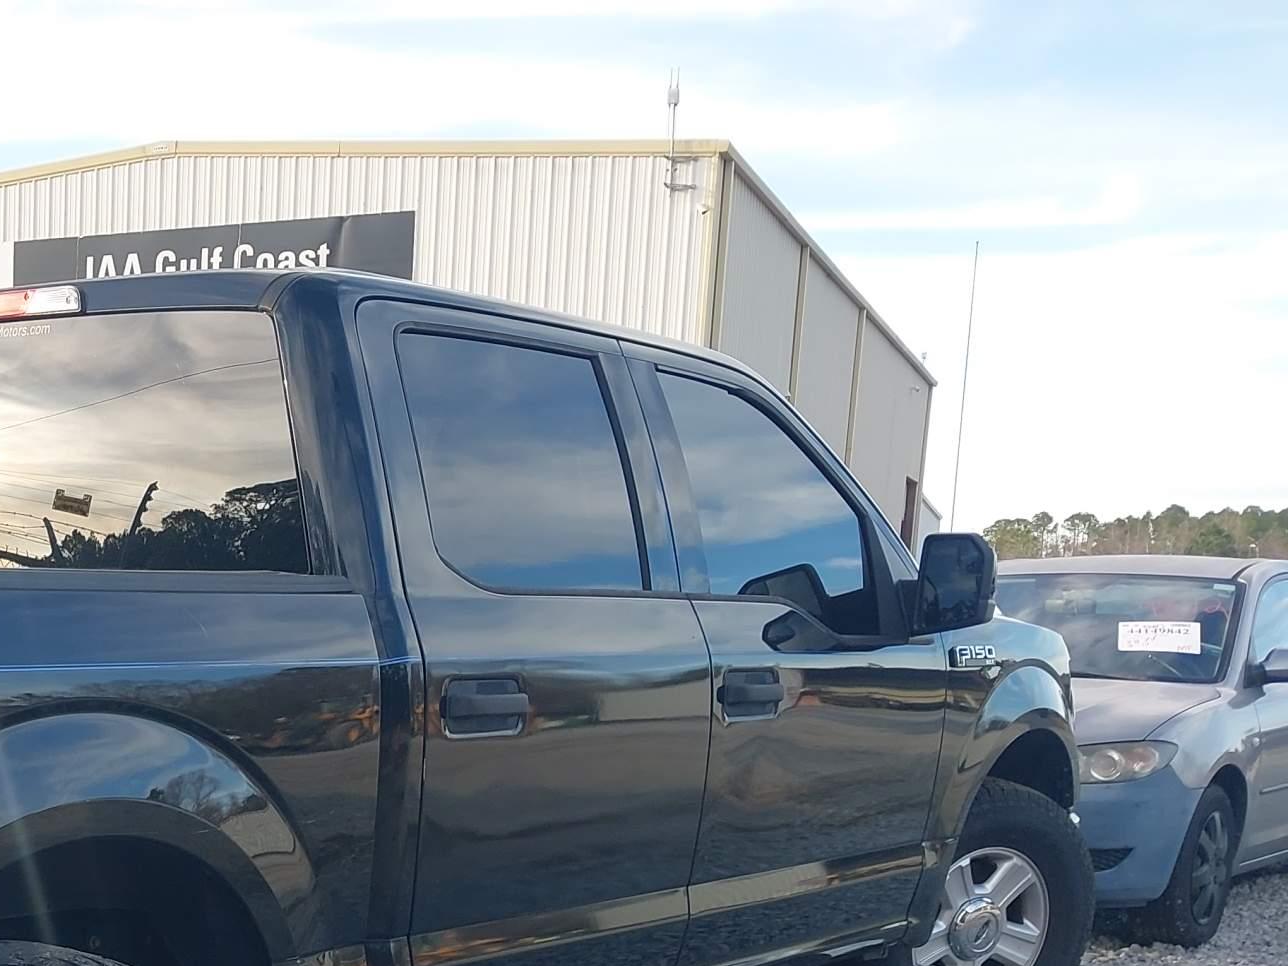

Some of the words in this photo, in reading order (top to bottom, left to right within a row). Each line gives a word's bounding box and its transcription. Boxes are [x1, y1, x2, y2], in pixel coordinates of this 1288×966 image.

[86, 253, 142, 279] IAA
[155, 246, 223, 273] Gulf
[233, 243, 330, 269] Coast
